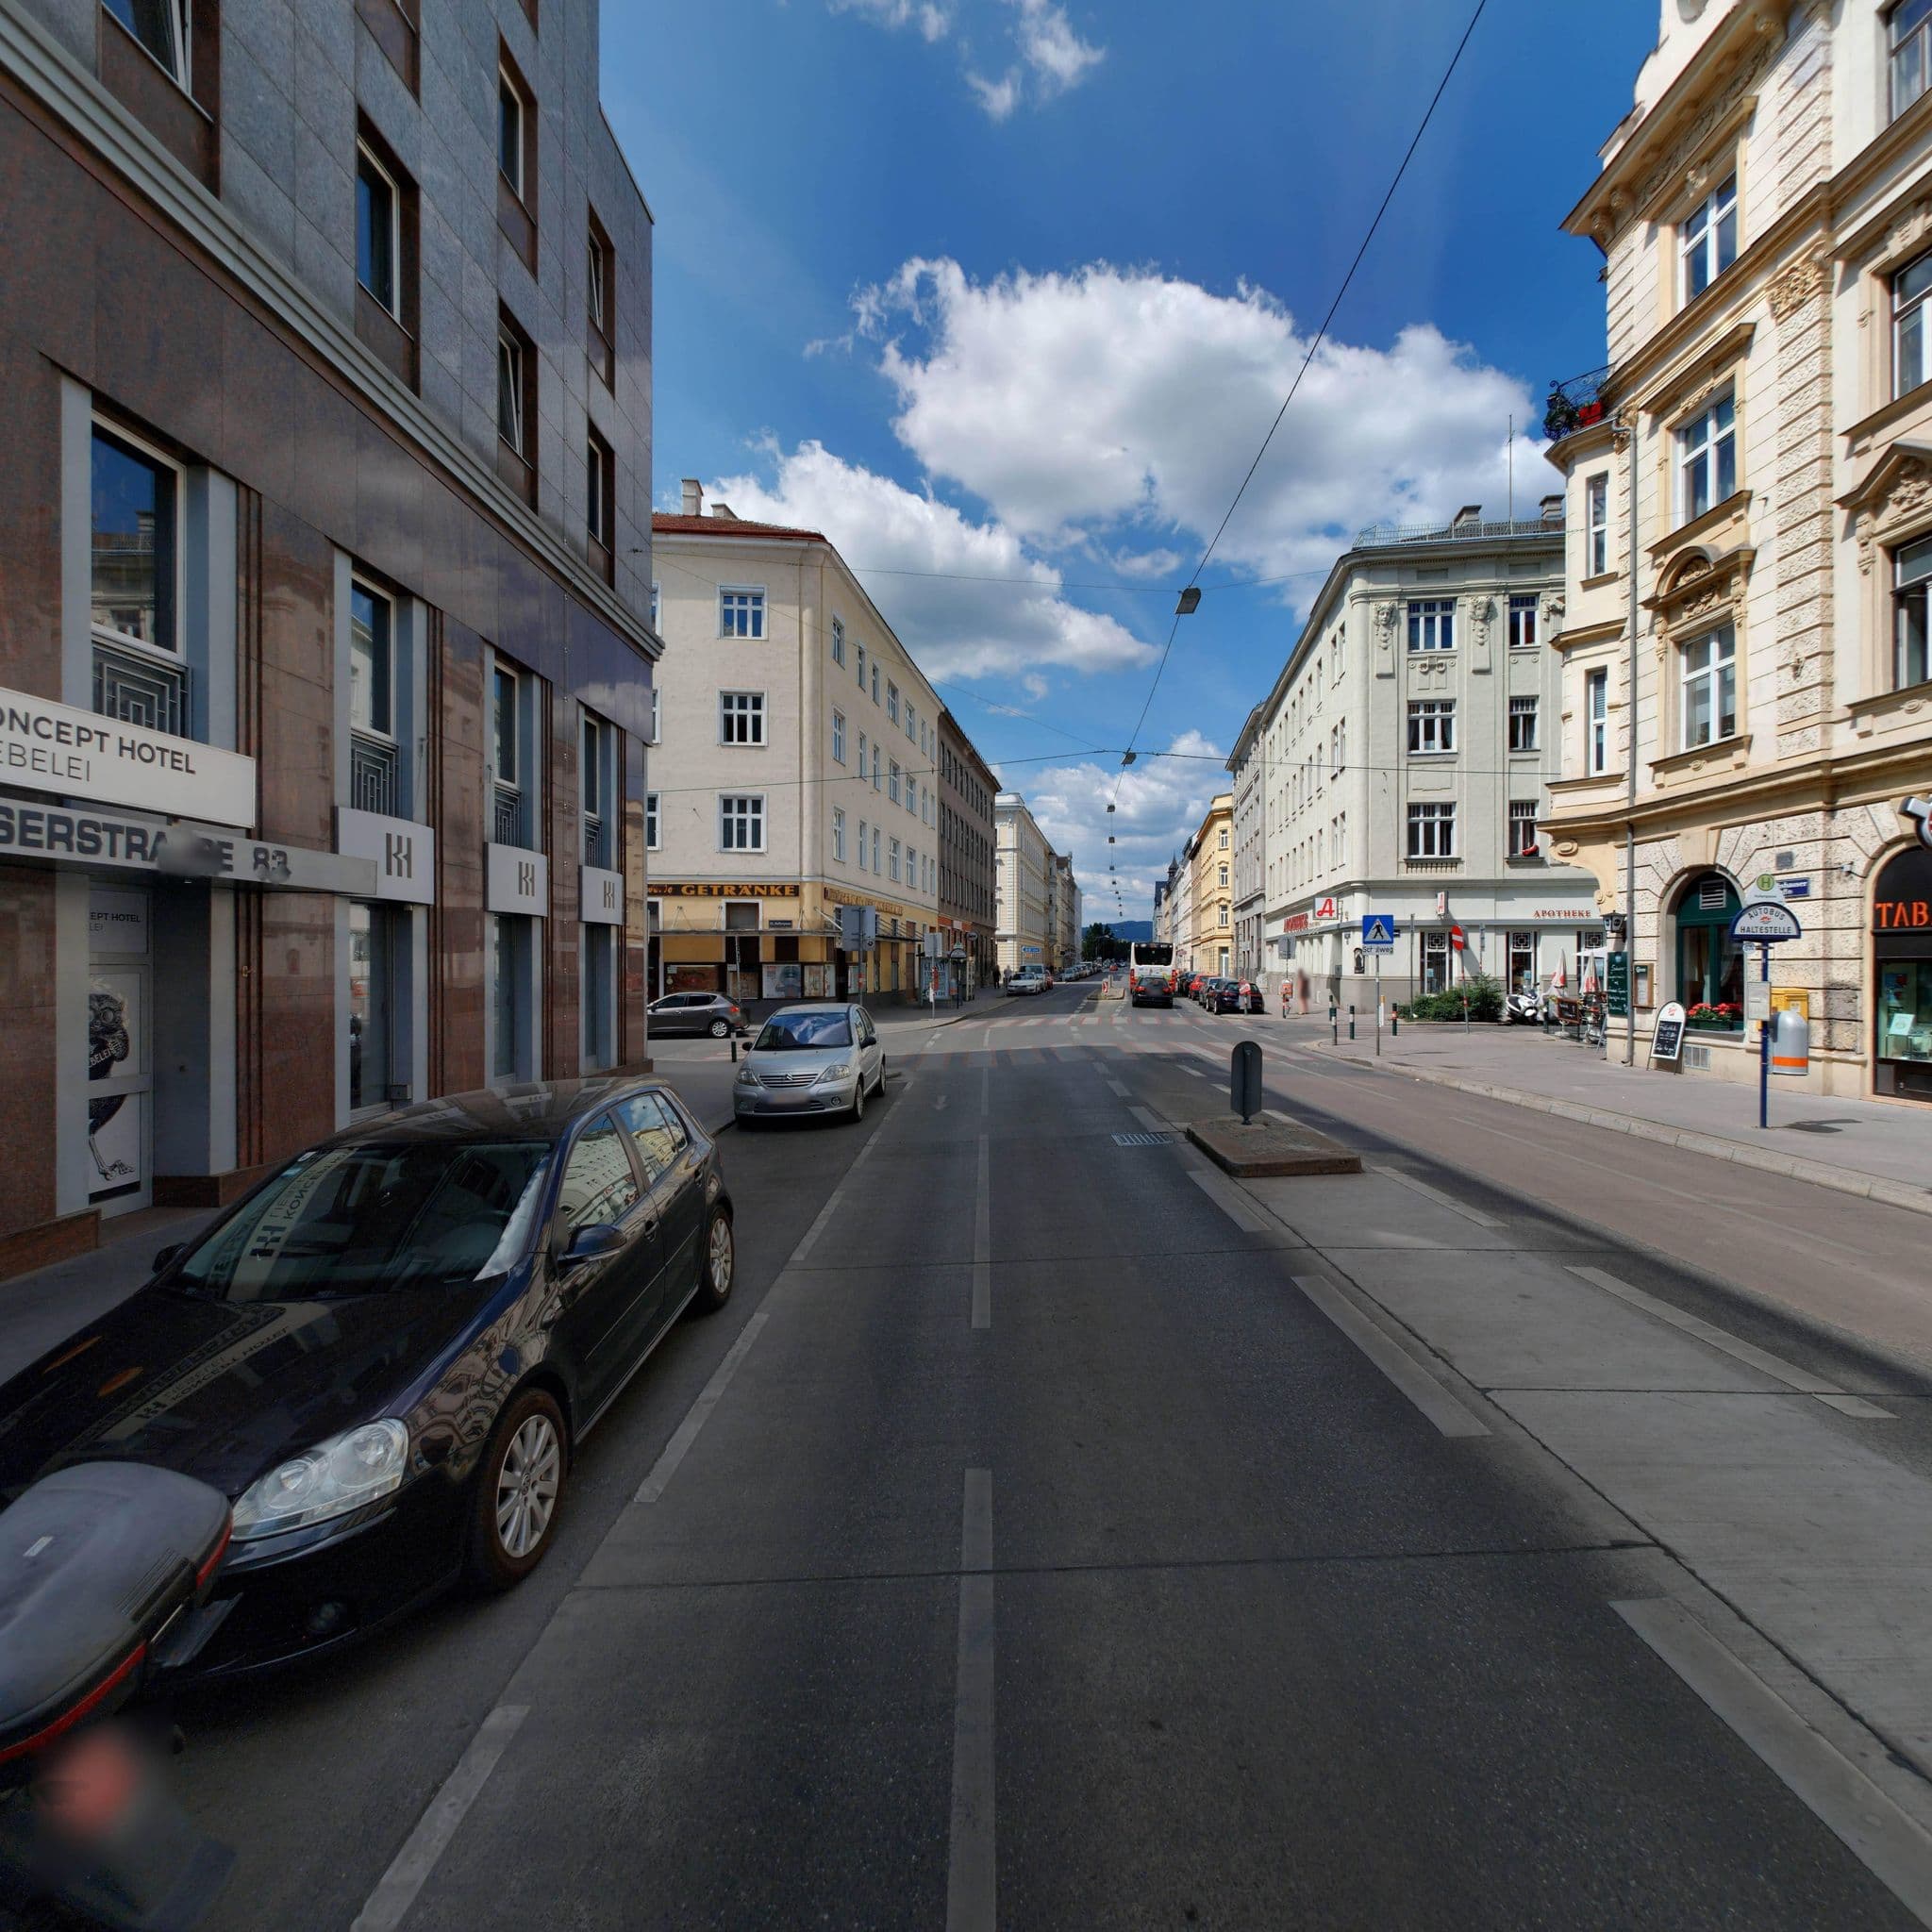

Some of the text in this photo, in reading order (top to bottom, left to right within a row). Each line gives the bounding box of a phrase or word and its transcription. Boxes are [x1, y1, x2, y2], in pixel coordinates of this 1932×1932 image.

[0, 708, 196, 774] NCEPT HOTEL
[0, 741, 91, 781] BELEI
[681, 884, 795, 896] GETRÄNKE
[1316, 898, 1335, 917] A
[1533, 909, 1591, 918] APOTHEKE
[111, 913, 141, 923] HOTEL
[1747, 908, 1786, 921] AUTOBUS
[1875, 901, 1932, 929] TAB
[1740, 925, 1791, 934] HALTESTELLE
